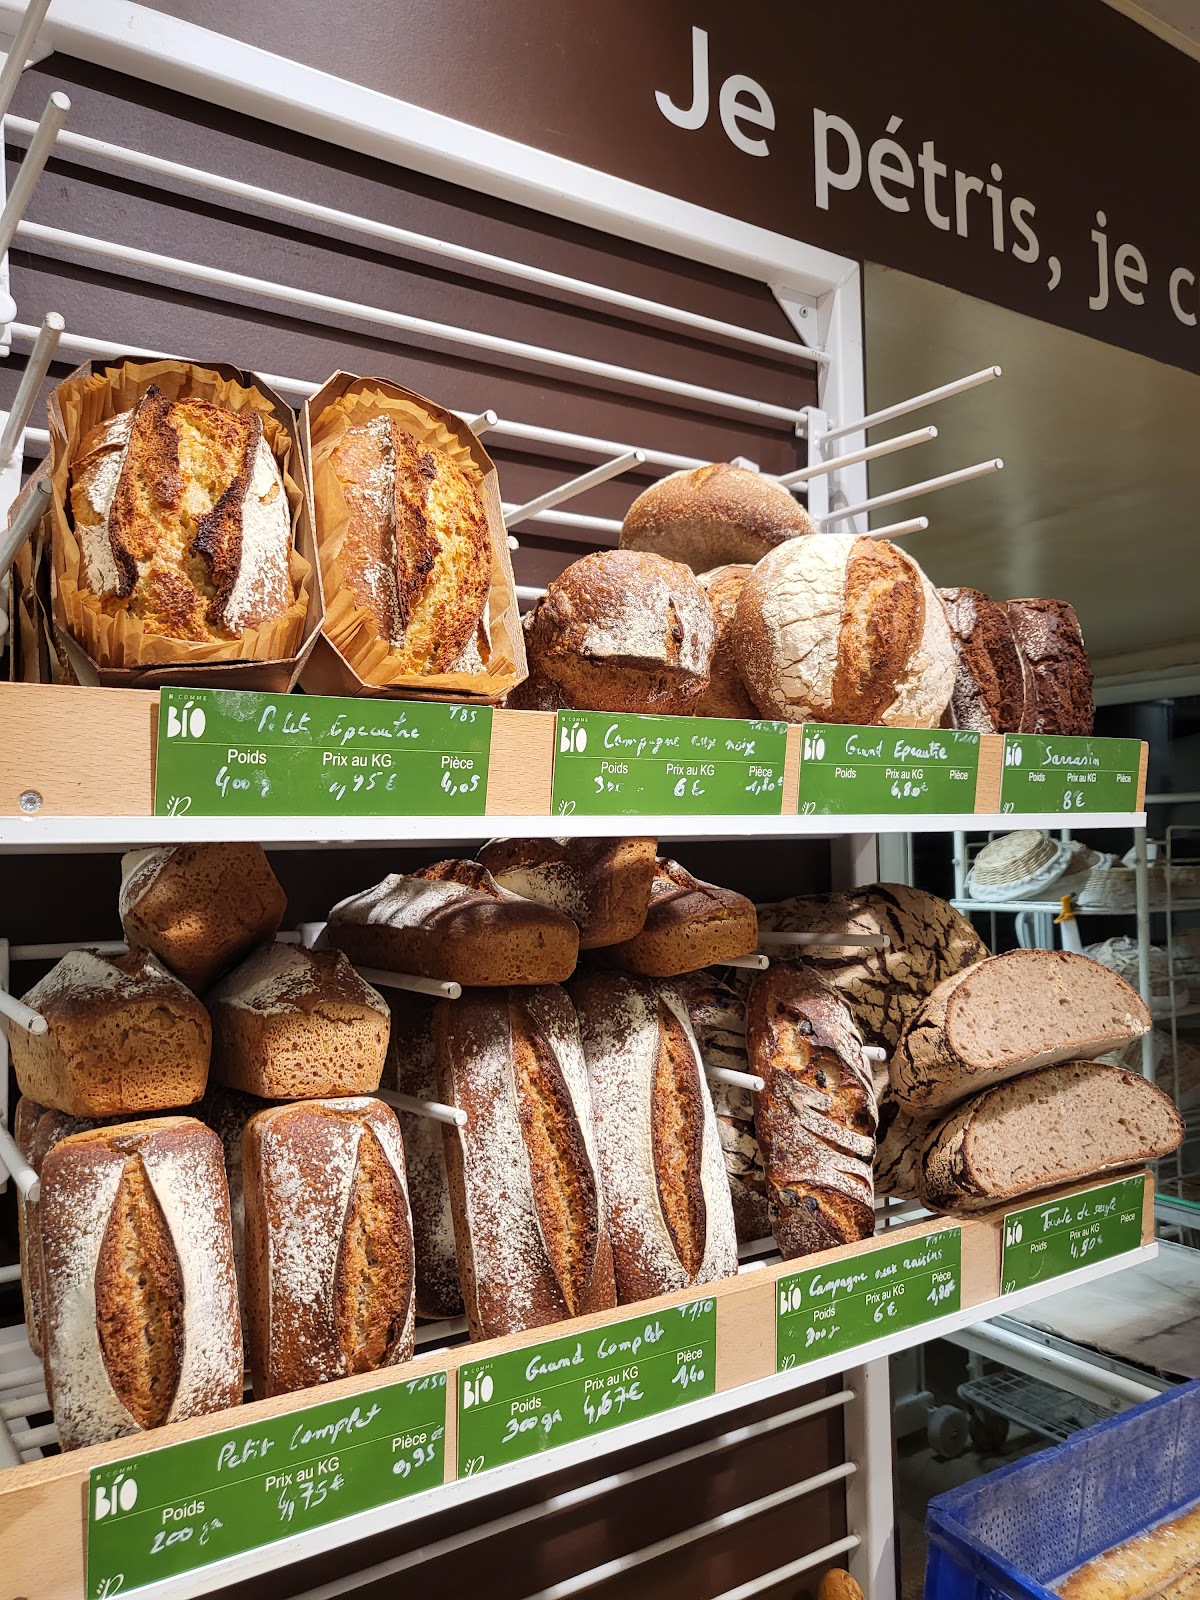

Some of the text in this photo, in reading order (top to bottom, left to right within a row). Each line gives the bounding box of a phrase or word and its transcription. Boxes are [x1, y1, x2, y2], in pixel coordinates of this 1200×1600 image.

[655, 25, 775, 156] Je
[814, 108, 1061, 291] pétris,
[1089, 210, 1148, 310] je
[227, 749, 267, 764] Poids
[323, 752, 392, 767] Prix au KG
[441, 756, 474, 769] Pièce
[1042, 746, 1100, 766] Sarrasin
[601, 761, 628, 774] Poids
[666, 764, 715, 776] Prix au KG
[749, 766, 772, 777] Pièce
[835, 767, 857, 779] Poids
[886, 769, 924, 779] Prix au KG
[949, 769, 969, 780] Pièce
[1028, 772, 1046, 782] Poids
[1067, 773, 1078, 782] Prix
[1087, 773, 1097, 783] KG
[1116, 774, 1131, 783] Pièce
[1120, 1213, 1135, 1224] Pièce
[1069, 1223, 1100, 1241] Prix au KG
[1030, 1241, 1047, 1254] Poids
[932, 1271, 952, 1284] Pièce
[865, 1284, 905, 1306] Prix au KG
[813, 1306, 836, 1322] Poids
[677, 1348, 703, 1365] Pièce
[584, 1366, 639, 1393] Prix au KG
[510, 1396, 542, 1416] Poids
[392, 1432, 427, 1452] Pièce
[265, 1457, 340, 1492] Prix au KG
[162, 1500, 205, 1525] Poids
